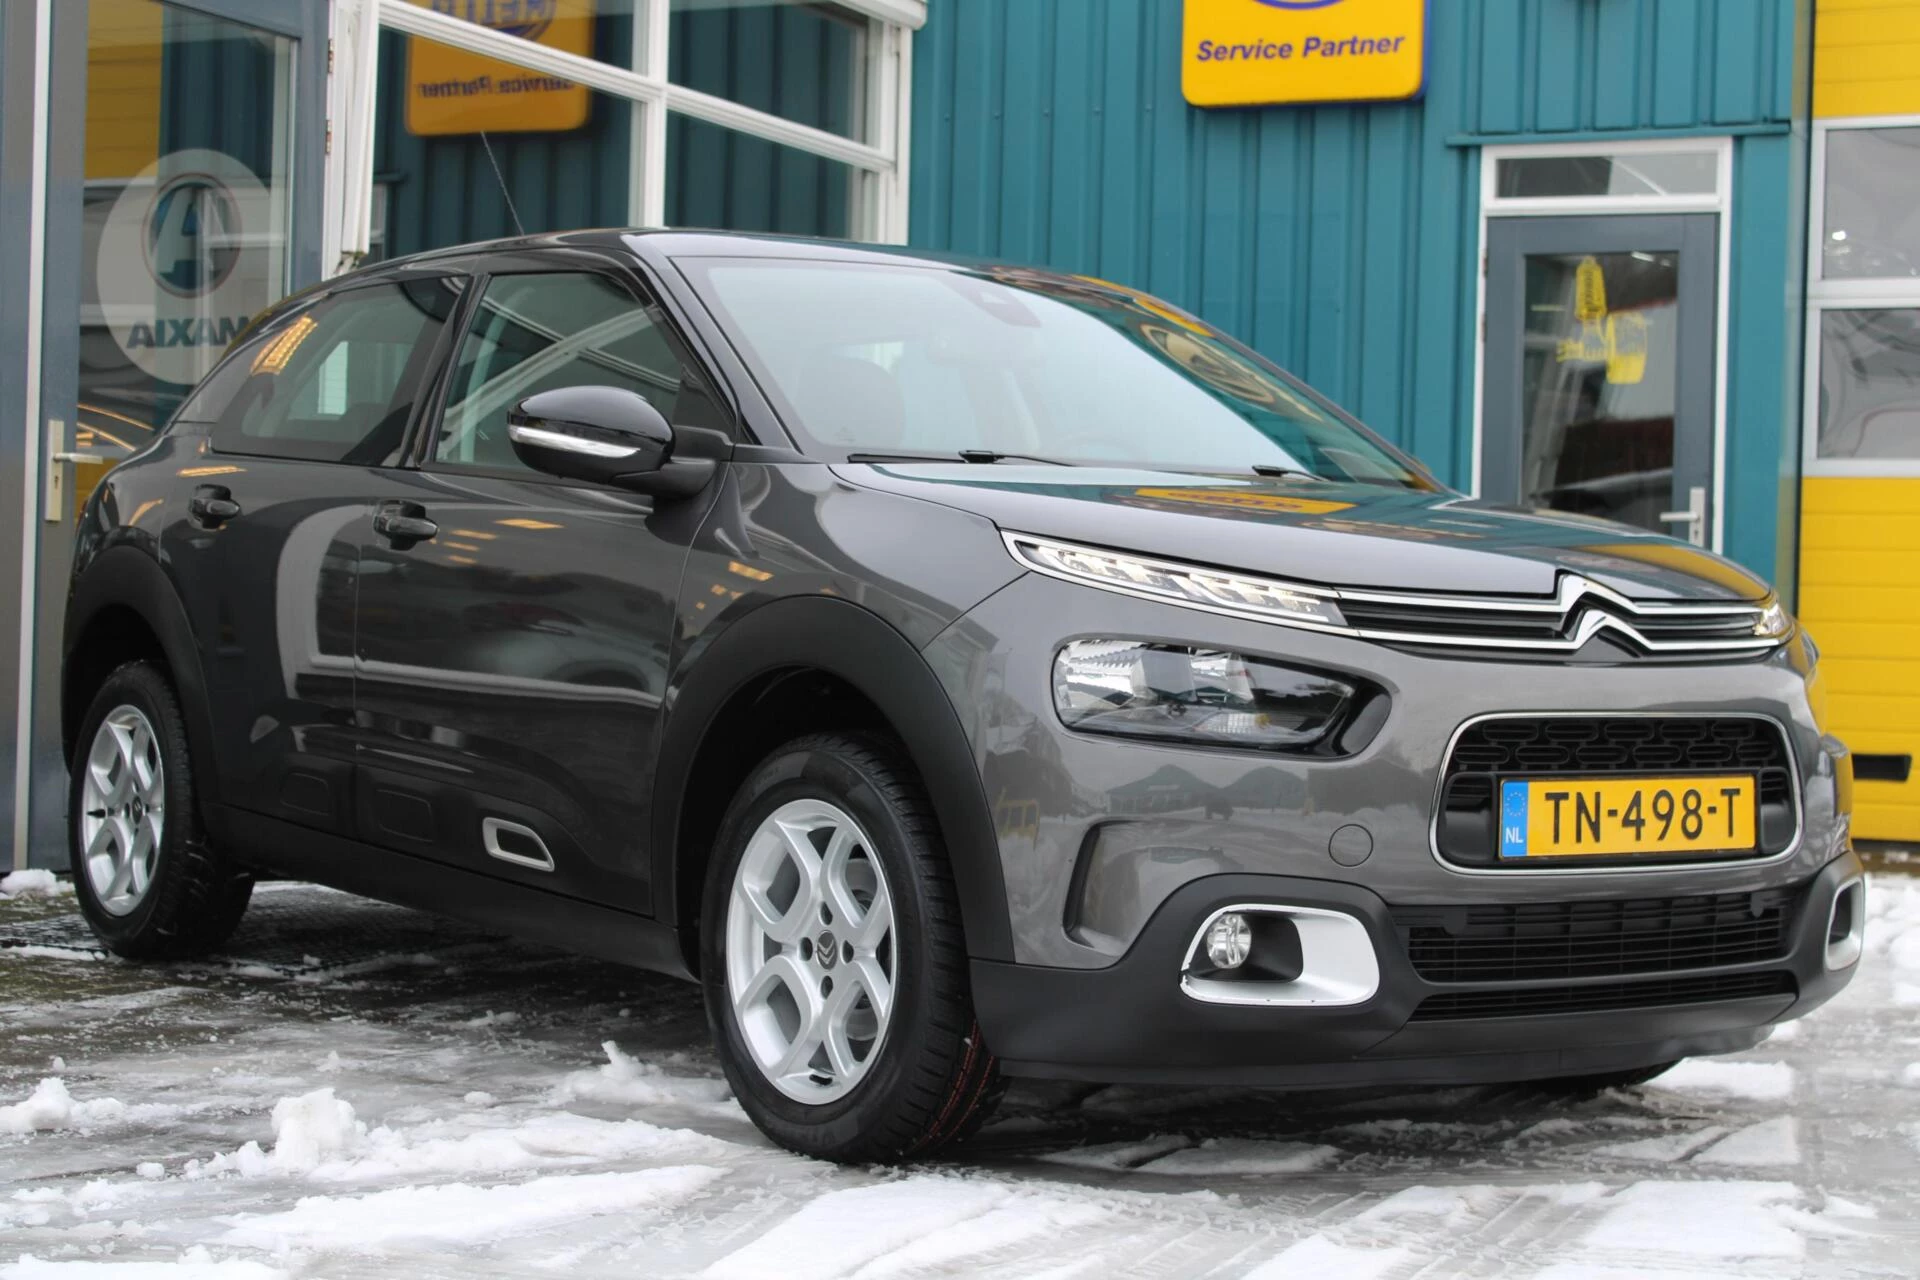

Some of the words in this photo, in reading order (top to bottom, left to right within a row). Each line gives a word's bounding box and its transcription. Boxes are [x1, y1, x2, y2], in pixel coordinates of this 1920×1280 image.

[1196, 40, 1293, 61] Service
[1302, 36, 1405, 58] Partner
[1545, 788, 1741, 844] TN-498-T
[1505, 827, 1524, 844] NL
